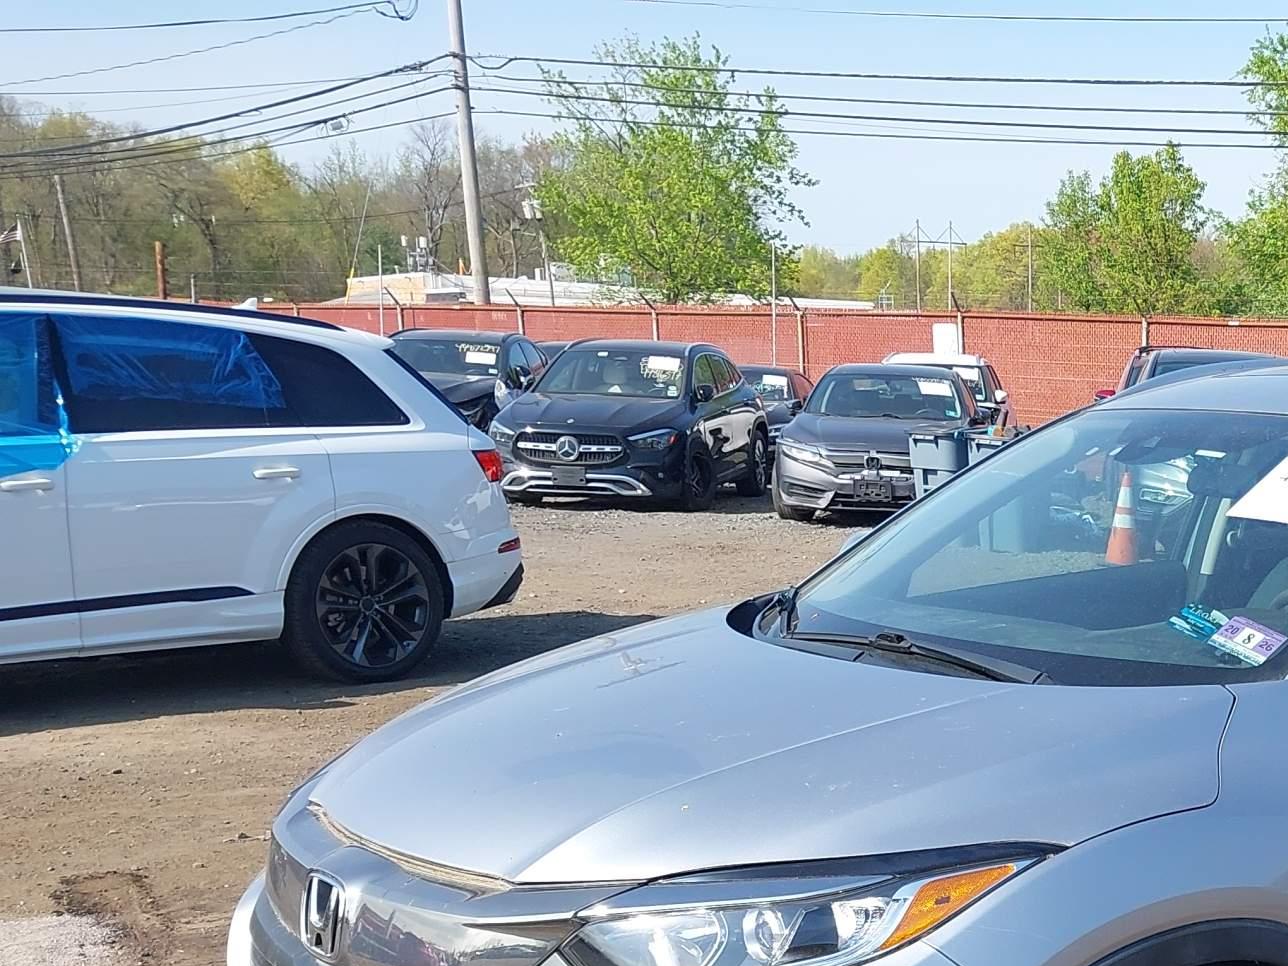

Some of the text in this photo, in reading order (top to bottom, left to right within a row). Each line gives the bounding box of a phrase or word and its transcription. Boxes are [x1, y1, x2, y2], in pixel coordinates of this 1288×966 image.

[1224, 624, 1240, 635] 20
[1242, 633, 1254, 645] 8
[1258, 640, 1274, 653] 26
